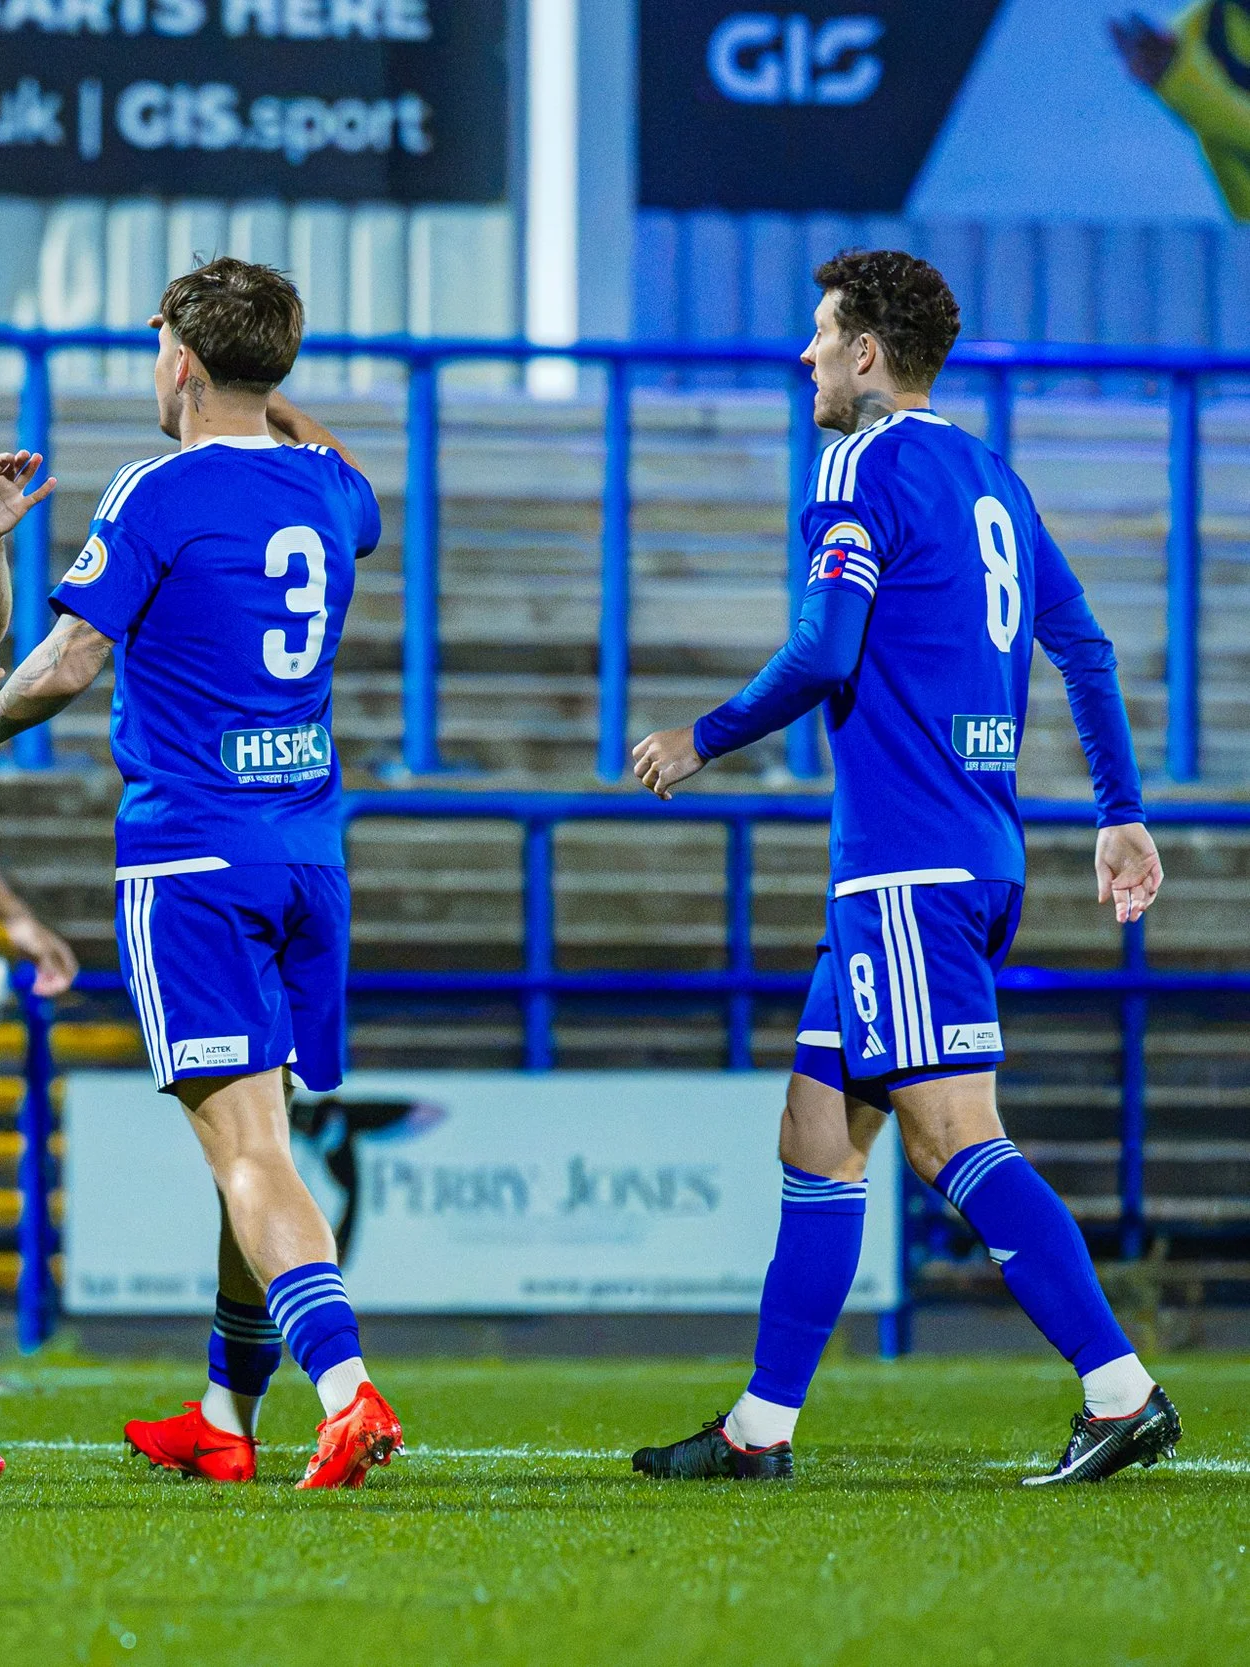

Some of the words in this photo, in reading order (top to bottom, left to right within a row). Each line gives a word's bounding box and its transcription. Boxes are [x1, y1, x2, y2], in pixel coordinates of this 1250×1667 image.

[707, 14, 884, 101] GIS
[115, 80, 433, 165] GIS.sport
[263, 525, 327, 680] 3
[818, 549, 845, 579] C
[973, 495, 1021, 652] 8
[849, 952, 878, 1024] 8
[205, 1045, 231, 1053] AZTEK
